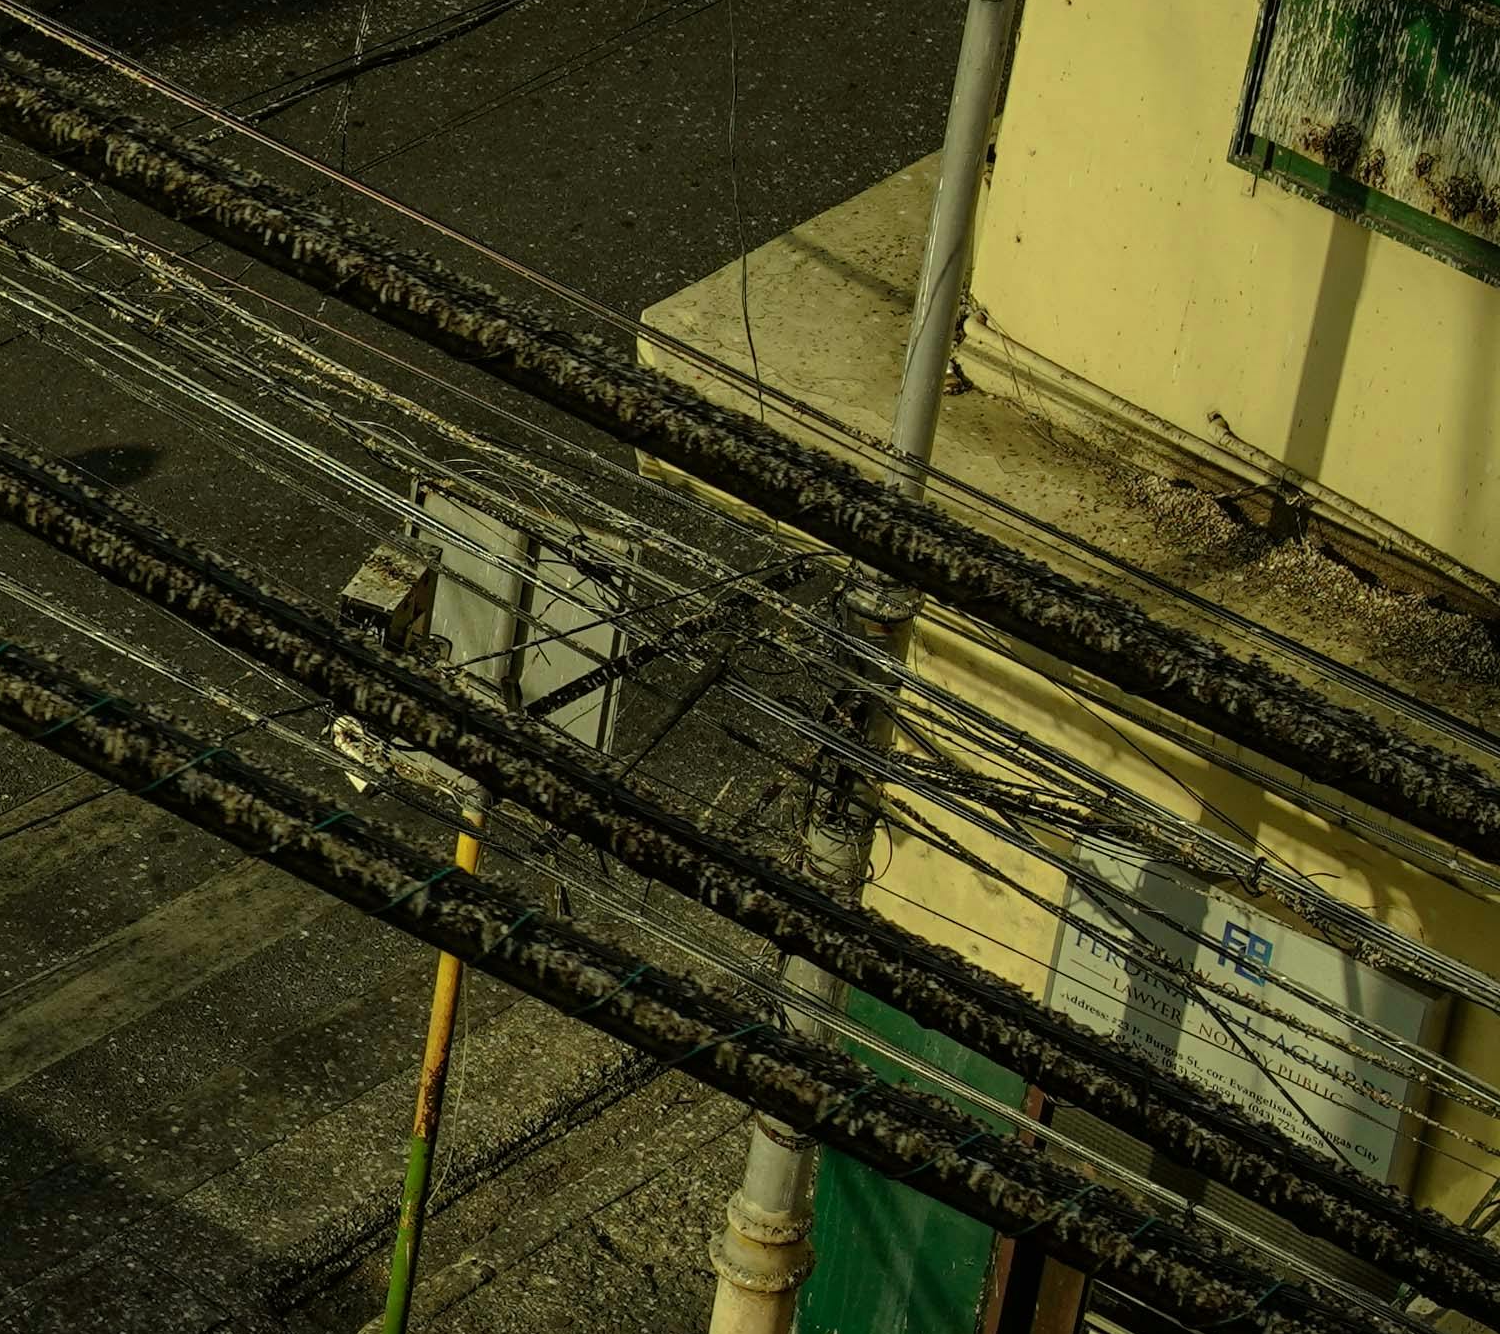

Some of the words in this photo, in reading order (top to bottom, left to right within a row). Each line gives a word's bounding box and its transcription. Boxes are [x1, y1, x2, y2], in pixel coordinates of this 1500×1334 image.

[1112, 978, 1182, 1025] LAWYER
[1278, 1064, 1343, 1101] PUBLIC
[1145, 1034, 1183, 1060] Burgos
[1354, 1145, 1379, 1164] City
